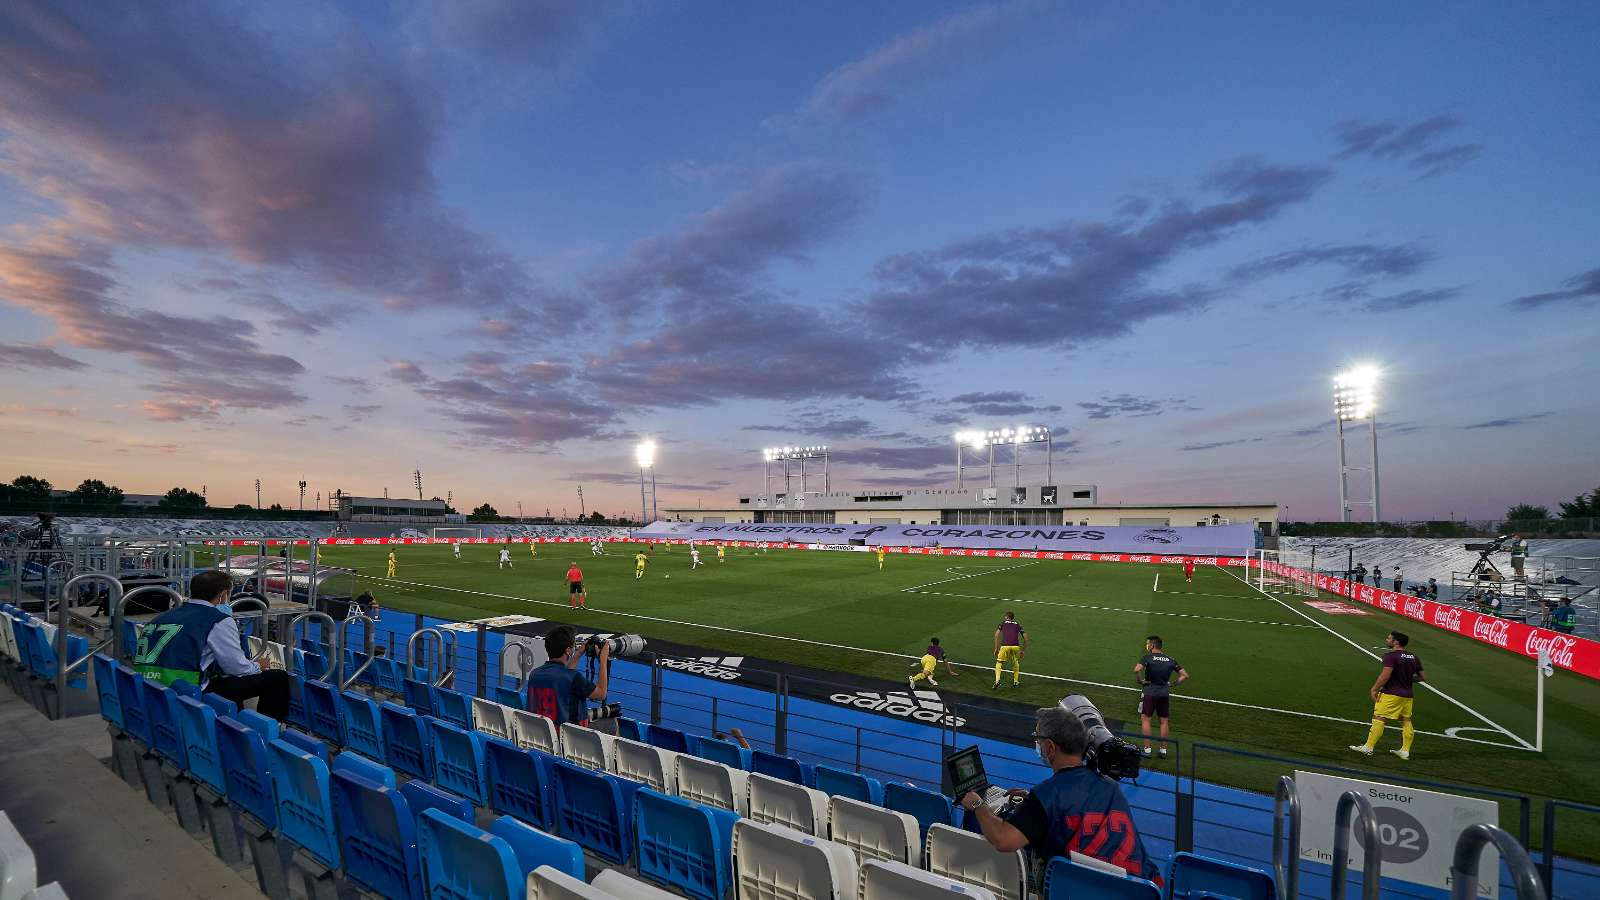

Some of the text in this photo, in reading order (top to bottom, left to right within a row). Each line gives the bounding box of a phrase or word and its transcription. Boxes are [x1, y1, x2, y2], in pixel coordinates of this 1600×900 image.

[695, 525, 1106, 541] EN NUESTROS CORAZONES
[1129, 555, 1152, 563] Coca-Cola
[1160, 556, 1184, 564] Coca-Cola
[1193, 557, 1217, 565] Coca-Cola
[1404, 598, 1425, 621] Coca-Cola
[1434, 605, 1461, 632] Coca-Cola
[1474, 616, 1511, 647] Coca-Cola
[1525, 629, 1577, 668] Coca-Cola
[829, 693, 967, 727] adidas
[1368, 788, 1414, 804] Sector
[1379, 823, 1421, 851] 02
[1316, 850, 1354, 866] Imr
